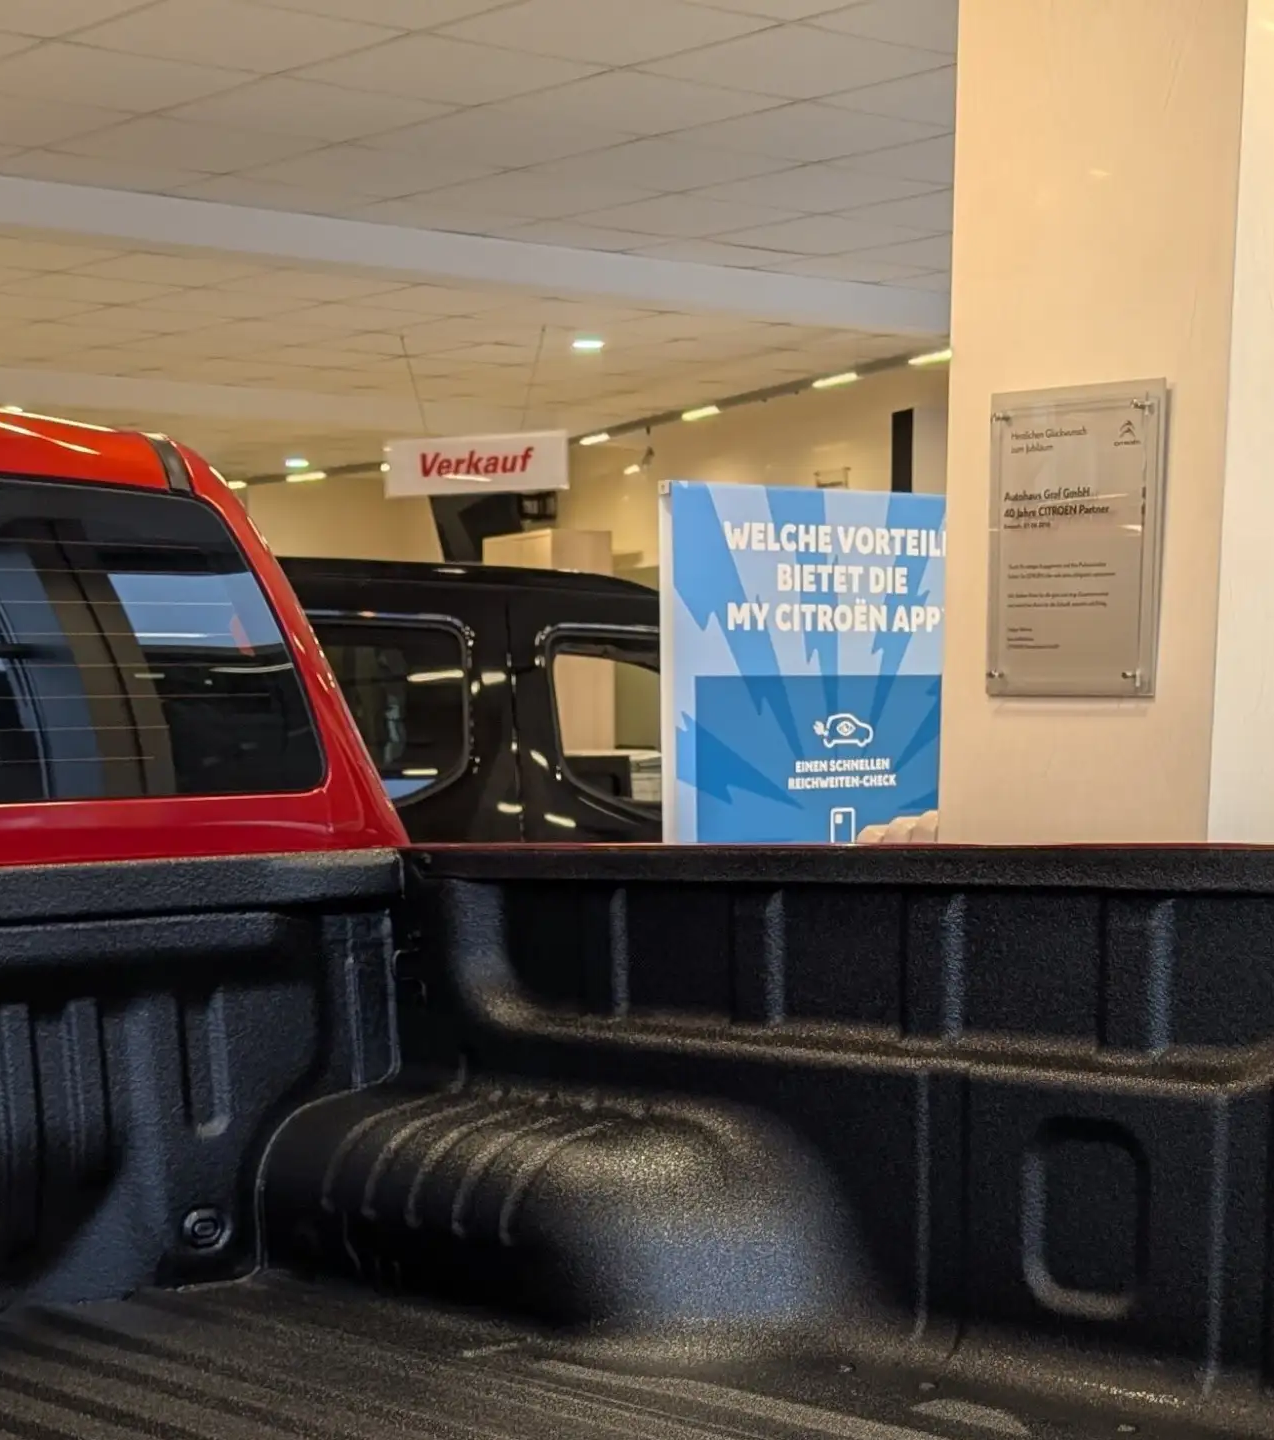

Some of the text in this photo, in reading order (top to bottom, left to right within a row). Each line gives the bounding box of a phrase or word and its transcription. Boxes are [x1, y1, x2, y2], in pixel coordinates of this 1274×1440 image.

[419, 447, 534, 478] Verkauf
[1004, 486, 1091, 502] Autohaus Graf GmbH
[1004, 508, 1016, 518] 40
[1017, 507, 1036, 519] Jahre
[1079, 504, 1110, 514] Partner
[723, 521, 946, 557] WELCHE VORTEIL
[777, 563, 909, 594] BIETET DIE
[727, 598, 945, 632] MY CITROËN APP
[795, 757, 890, 773] EINEN SCHNELLEN
[788, 774, 897, 790] REICHWEITEN-CHECK
